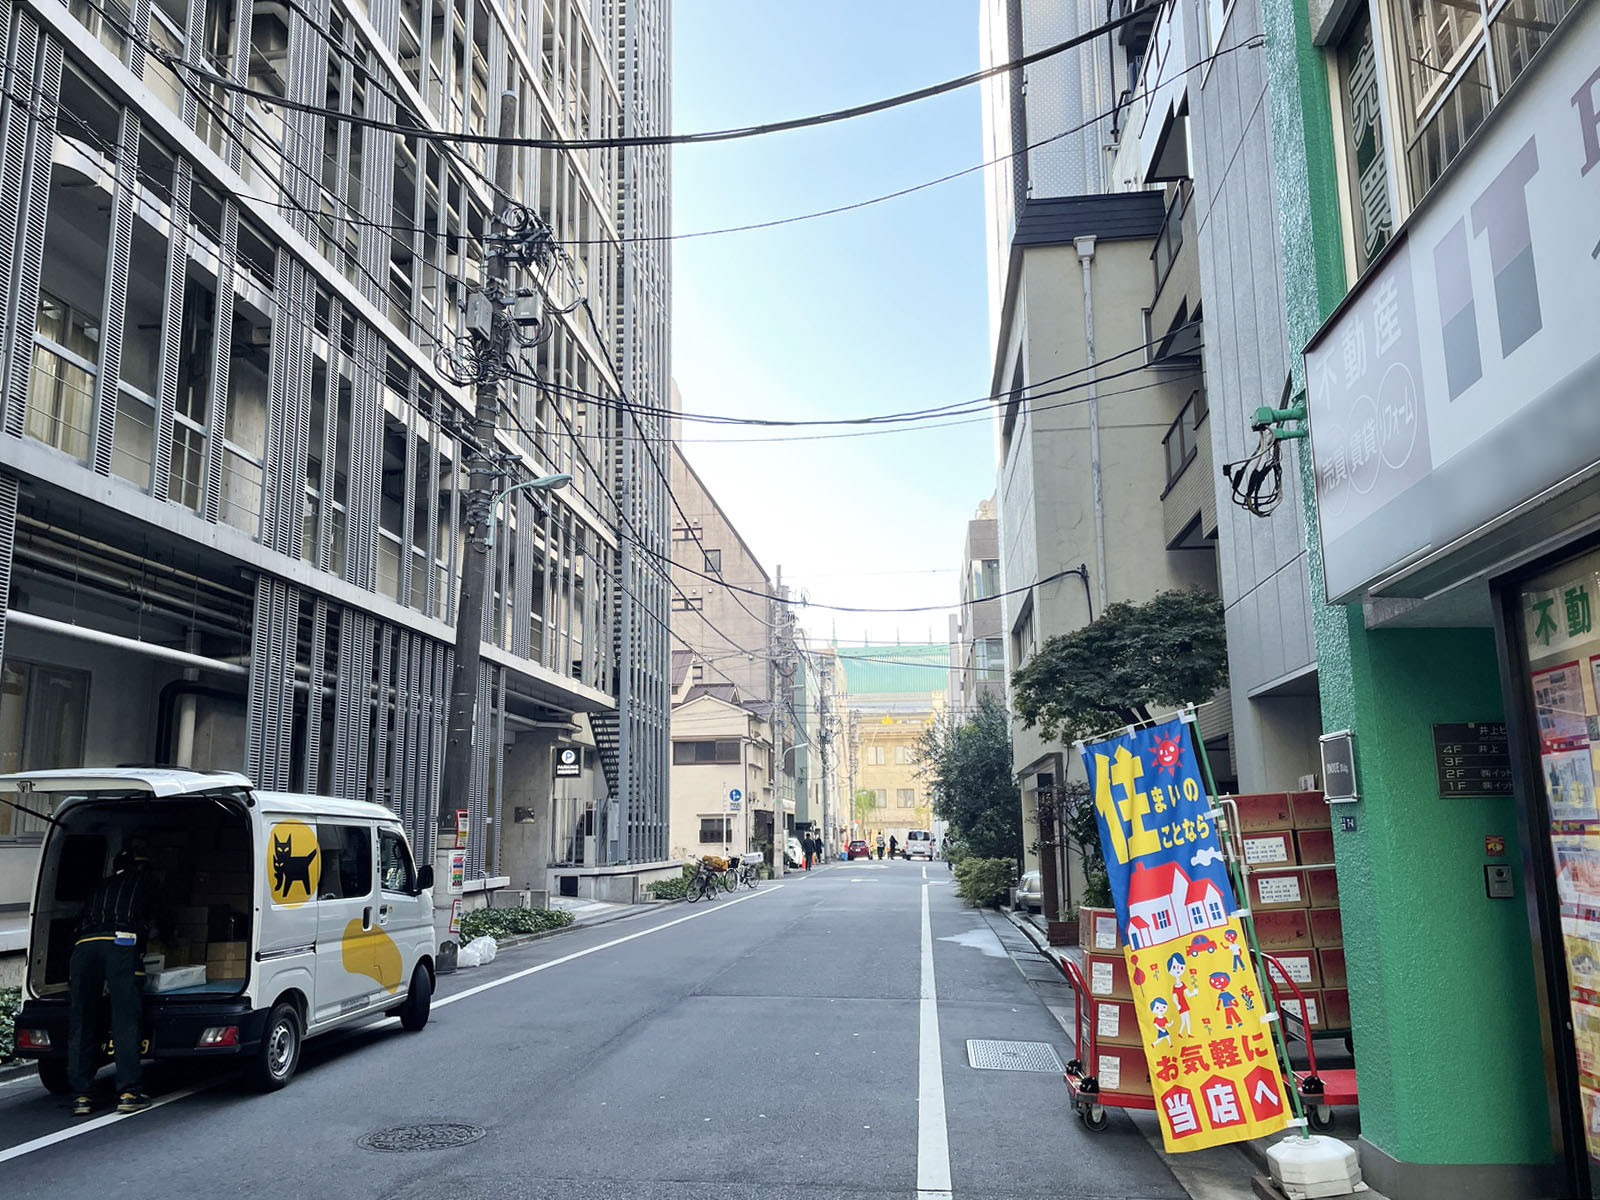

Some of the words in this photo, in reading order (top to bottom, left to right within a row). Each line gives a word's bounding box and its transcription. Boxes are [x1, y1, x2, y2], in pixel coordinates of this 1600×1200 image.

[1432, 134, 1542, 403] IT
[1314, 275, 1402, 411] 不動産
[1378, 383, 1415, 447] リフォーム
[1350, 417, 1377, 473] 賃貸
[1532, 584, 1593, 647] 不動
[1443, 744, 1462, 754] 4F
[1479, 744, 1499, 753] 井上
[1444, 757, 1464, 766] 3F
[1445, 769, 1465, 779] 2F
[1095, 744, 1162, 865] 住
[1151, 777, 1200, 814] まいの
[1448, 781, 1467, 791] 1F
[1161, 814, 1211, 849] ことなら
[1156, 1032, 1269, 1082] お気軽に
[1167, 1082, 1280, 1133] 当店へ
